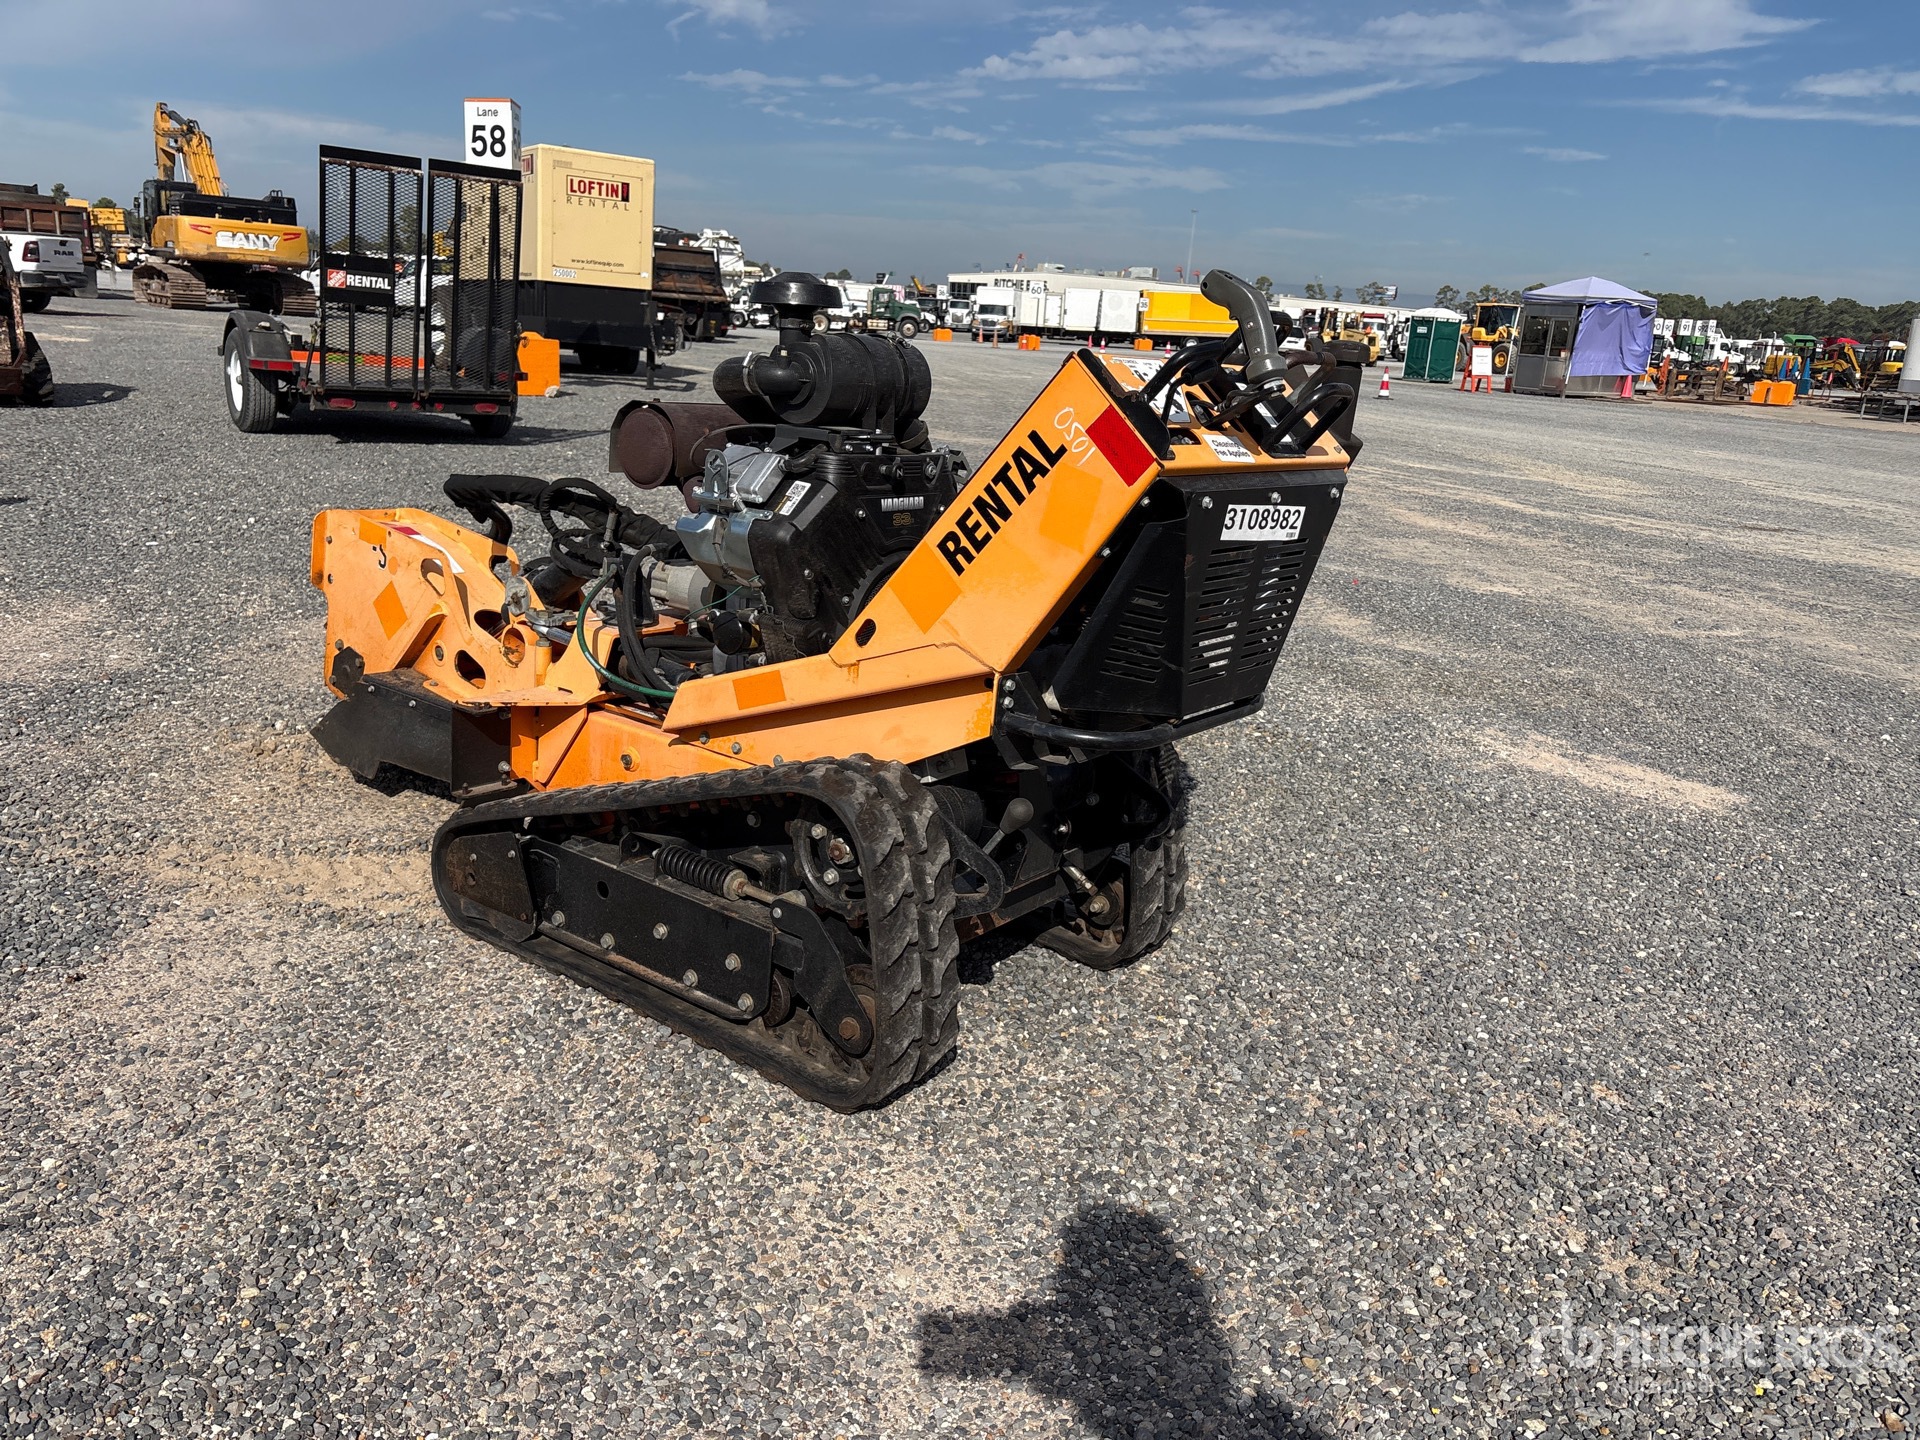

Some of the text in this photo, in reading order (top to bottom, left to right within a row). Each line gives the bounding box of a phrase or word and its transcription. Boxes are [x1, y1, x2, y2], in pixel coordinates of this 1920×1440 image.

[477, 107, 499, 117] Lane
[471, 124, 506, 158] 58
[569, 178, 620, 199] LOFTIN
[566, 195, 630, 212] RENTAL
[215, 231, 280, 252] SANY
[346, 274, 392, 290] RENTAL
[994, 278, 1025, 291] RITCHIE
[1031, 286, 1042, 295] 60
[1212, 439, 1241, 450] Cleaning
[1227, 449, 1251, 458] Applies
[881, 496, 924, 512] VANGUARD
[937, 430, 1068, 577] RENTAL
[1224, 508, 1302, 531] 3108982
